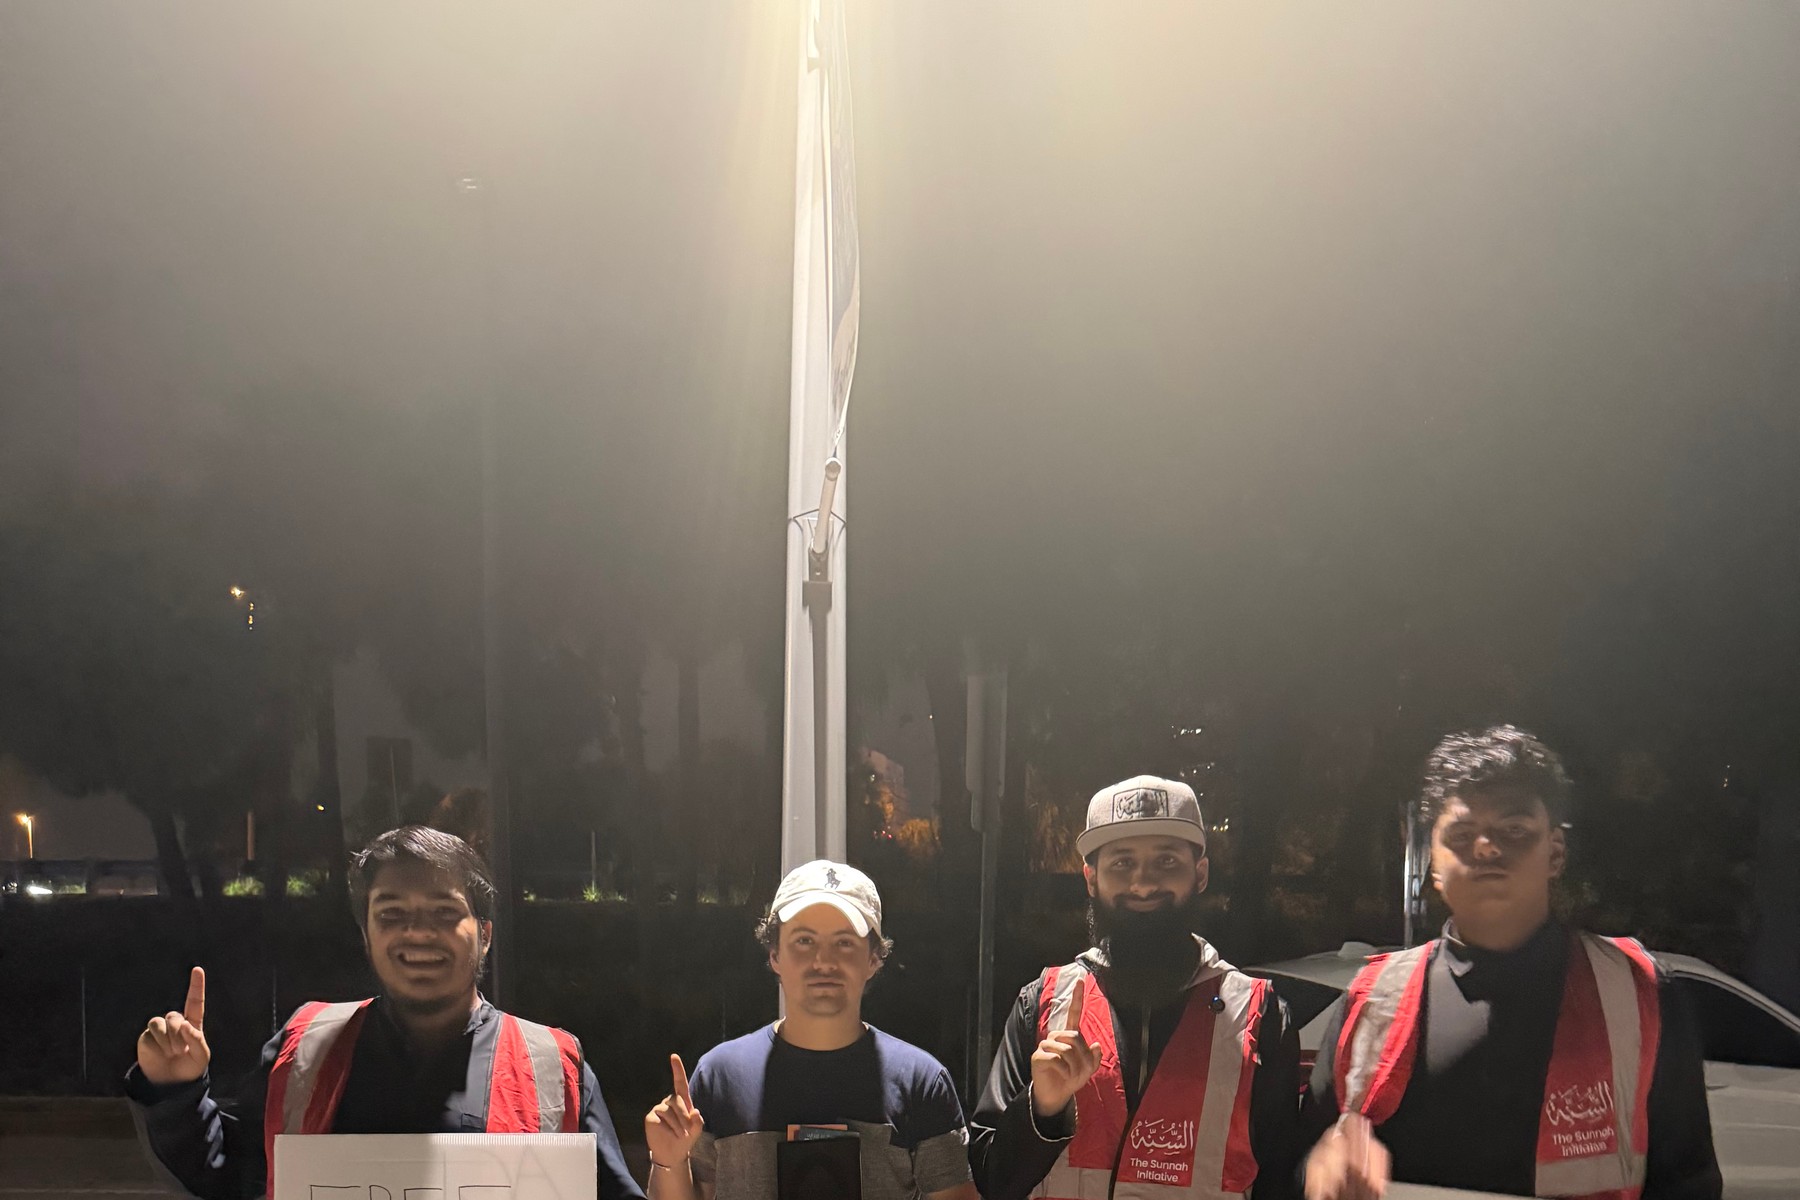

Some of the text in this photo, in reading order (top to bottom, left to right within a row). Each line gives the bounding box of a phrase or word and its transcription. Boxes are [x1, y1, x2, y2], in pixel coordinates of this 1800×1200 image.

[1552, 1132, 1573, 1145] The
[1130, 1157, 1188, 1172] The Sunnah
[1136, 1169, 1179, 1183] Initiative
